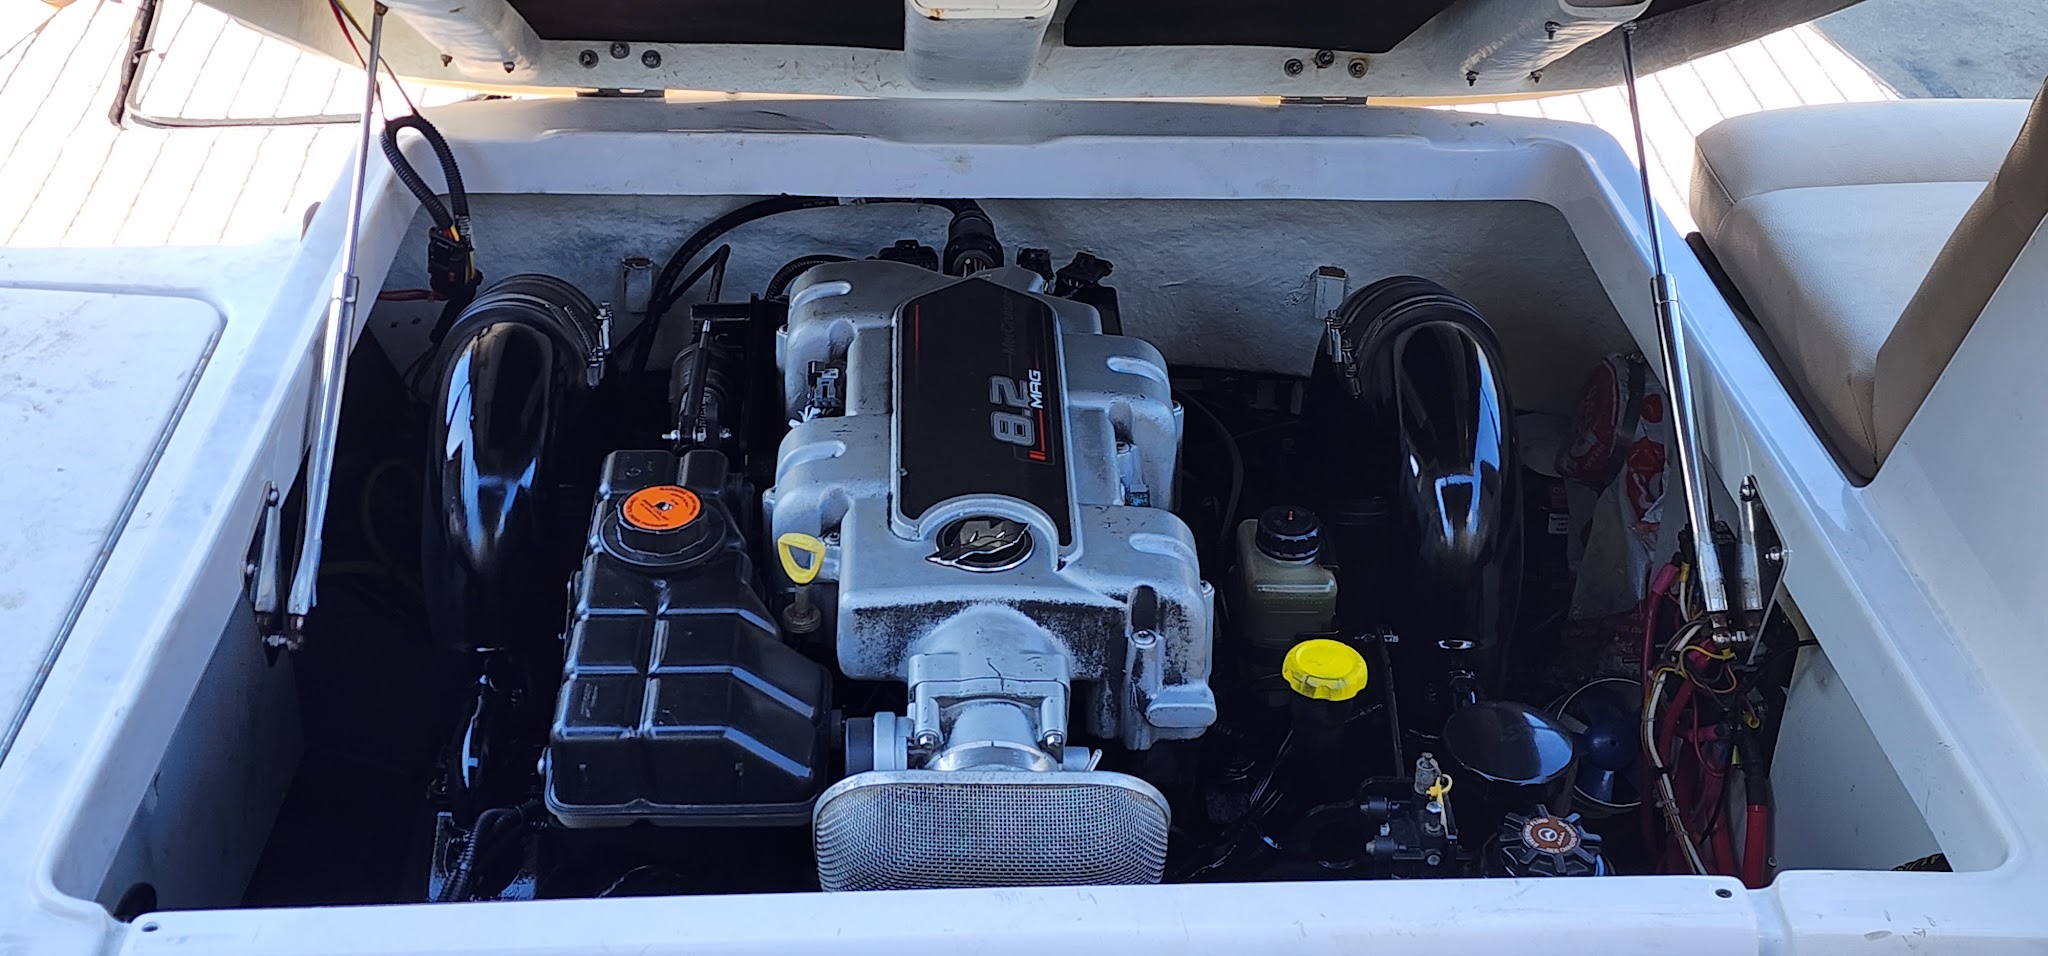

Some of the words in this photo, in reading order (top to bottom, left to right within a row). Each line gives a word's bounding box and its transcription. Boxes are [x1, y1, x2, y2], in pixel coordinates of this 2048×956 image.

[1000, 290, 1016, 356] MerCruis
[990, 375, 1035, 446] 8.2
[1028, 369, 1043, 409] MAG
